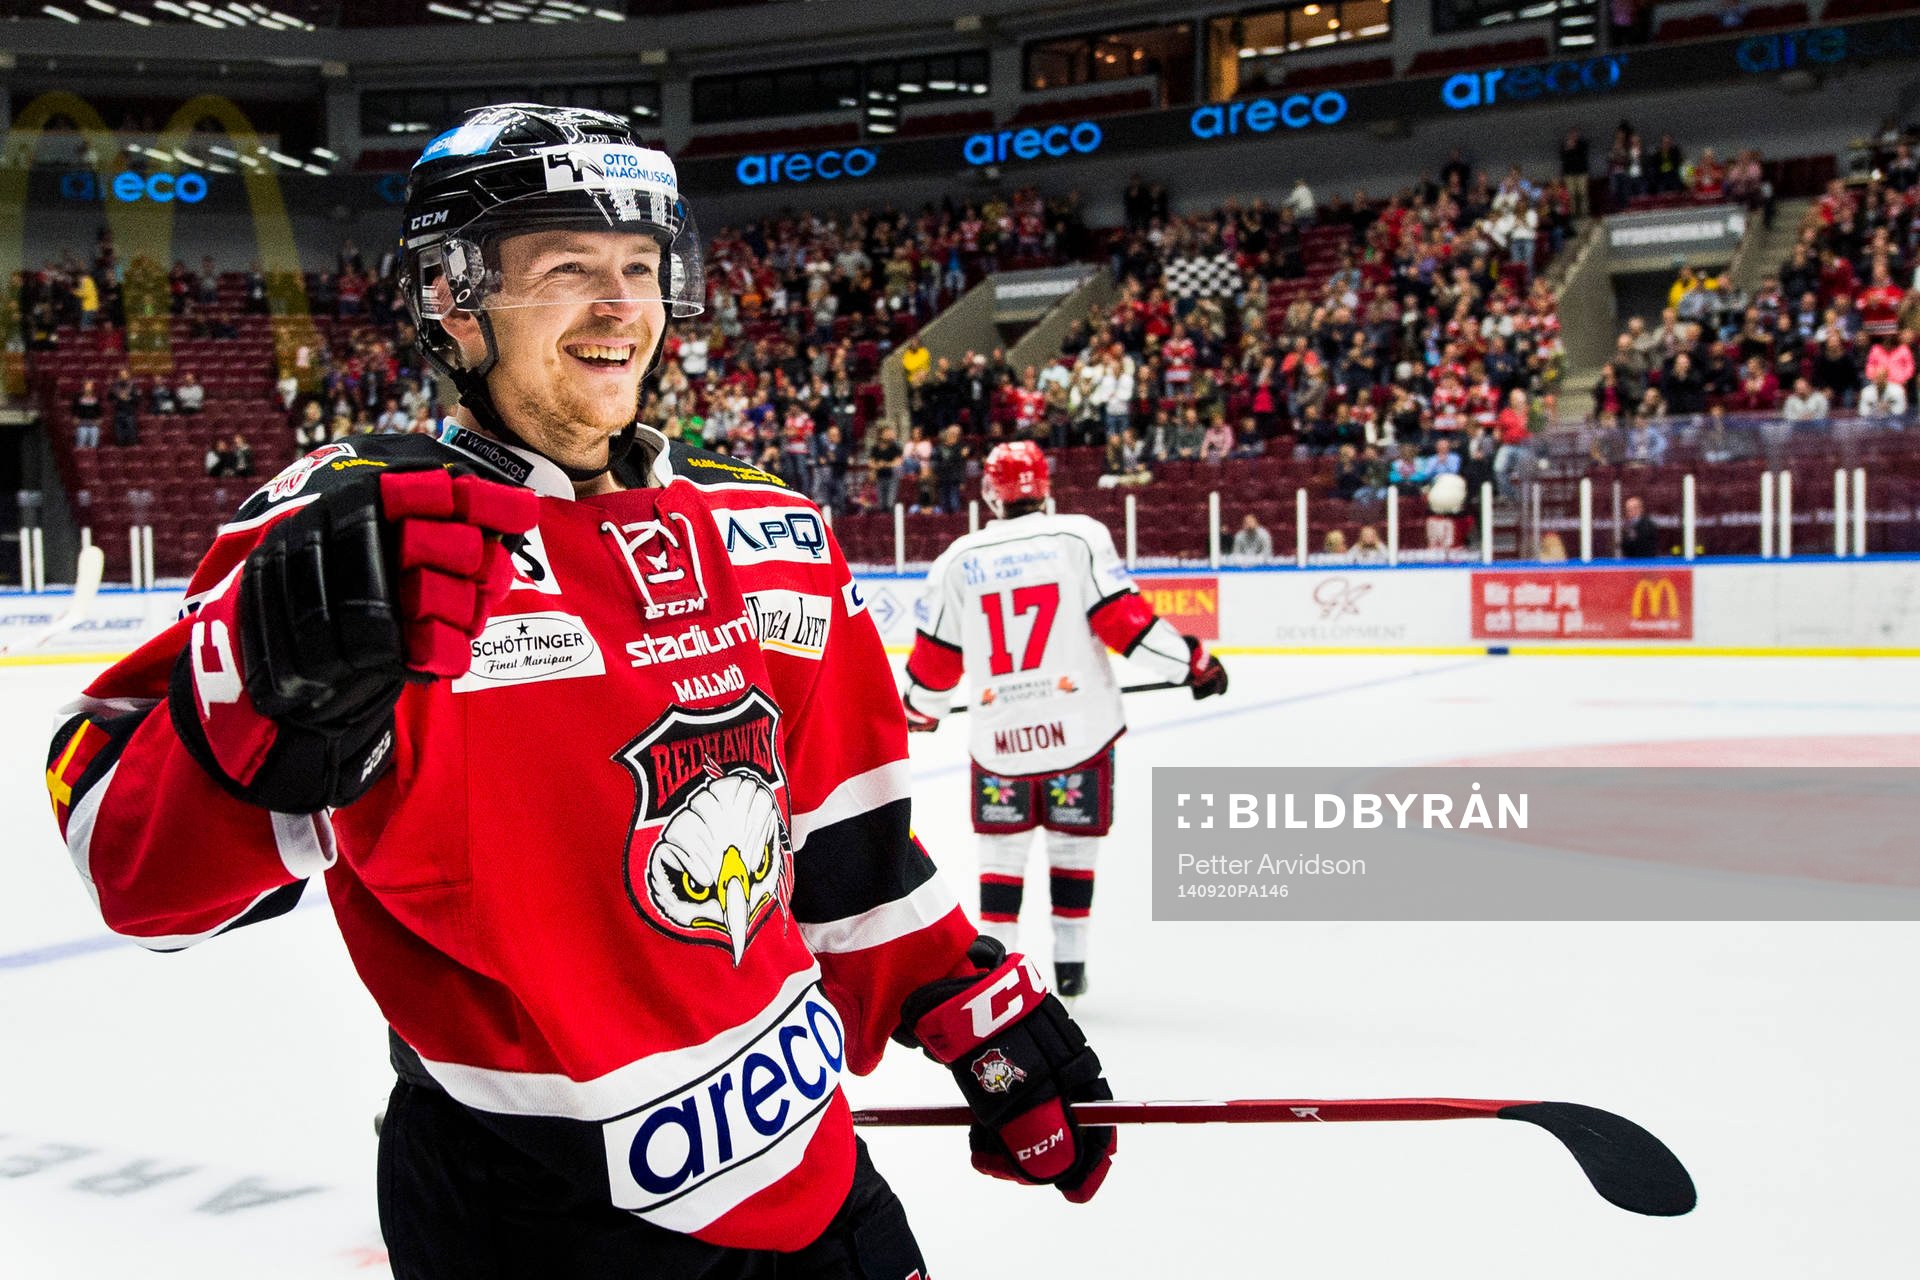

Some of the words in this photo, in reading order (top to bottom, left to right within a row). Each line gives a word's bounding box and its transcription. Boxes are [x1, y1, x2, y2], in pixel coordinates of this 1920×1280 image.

[1190, 90, 1348, 139] areco
[602, 152, 638, 167] OTTO
[963, 121, 1102, 165] areco
[604, 166, 677, 190] MAGNUSSON
[736, 148, 877, 186] areco
[411, 209, 450, 231] CCM
[471, 633, 585, 658] SCHÖTTINGER
[625, 610, 757, 668] stadium
[981, 582, 1061, 677] 17
[1276, 624, 1408, 641] DEVELOPMENT
[672, 664, 746, 703] MALMÖ
[994, 721, 1066, 755] MILTON
[651, 716, 773, 811] REDHAWKS
[628, 1000, 843, 1195] areco
[1016, 1127, 1065, 1162] CCM
